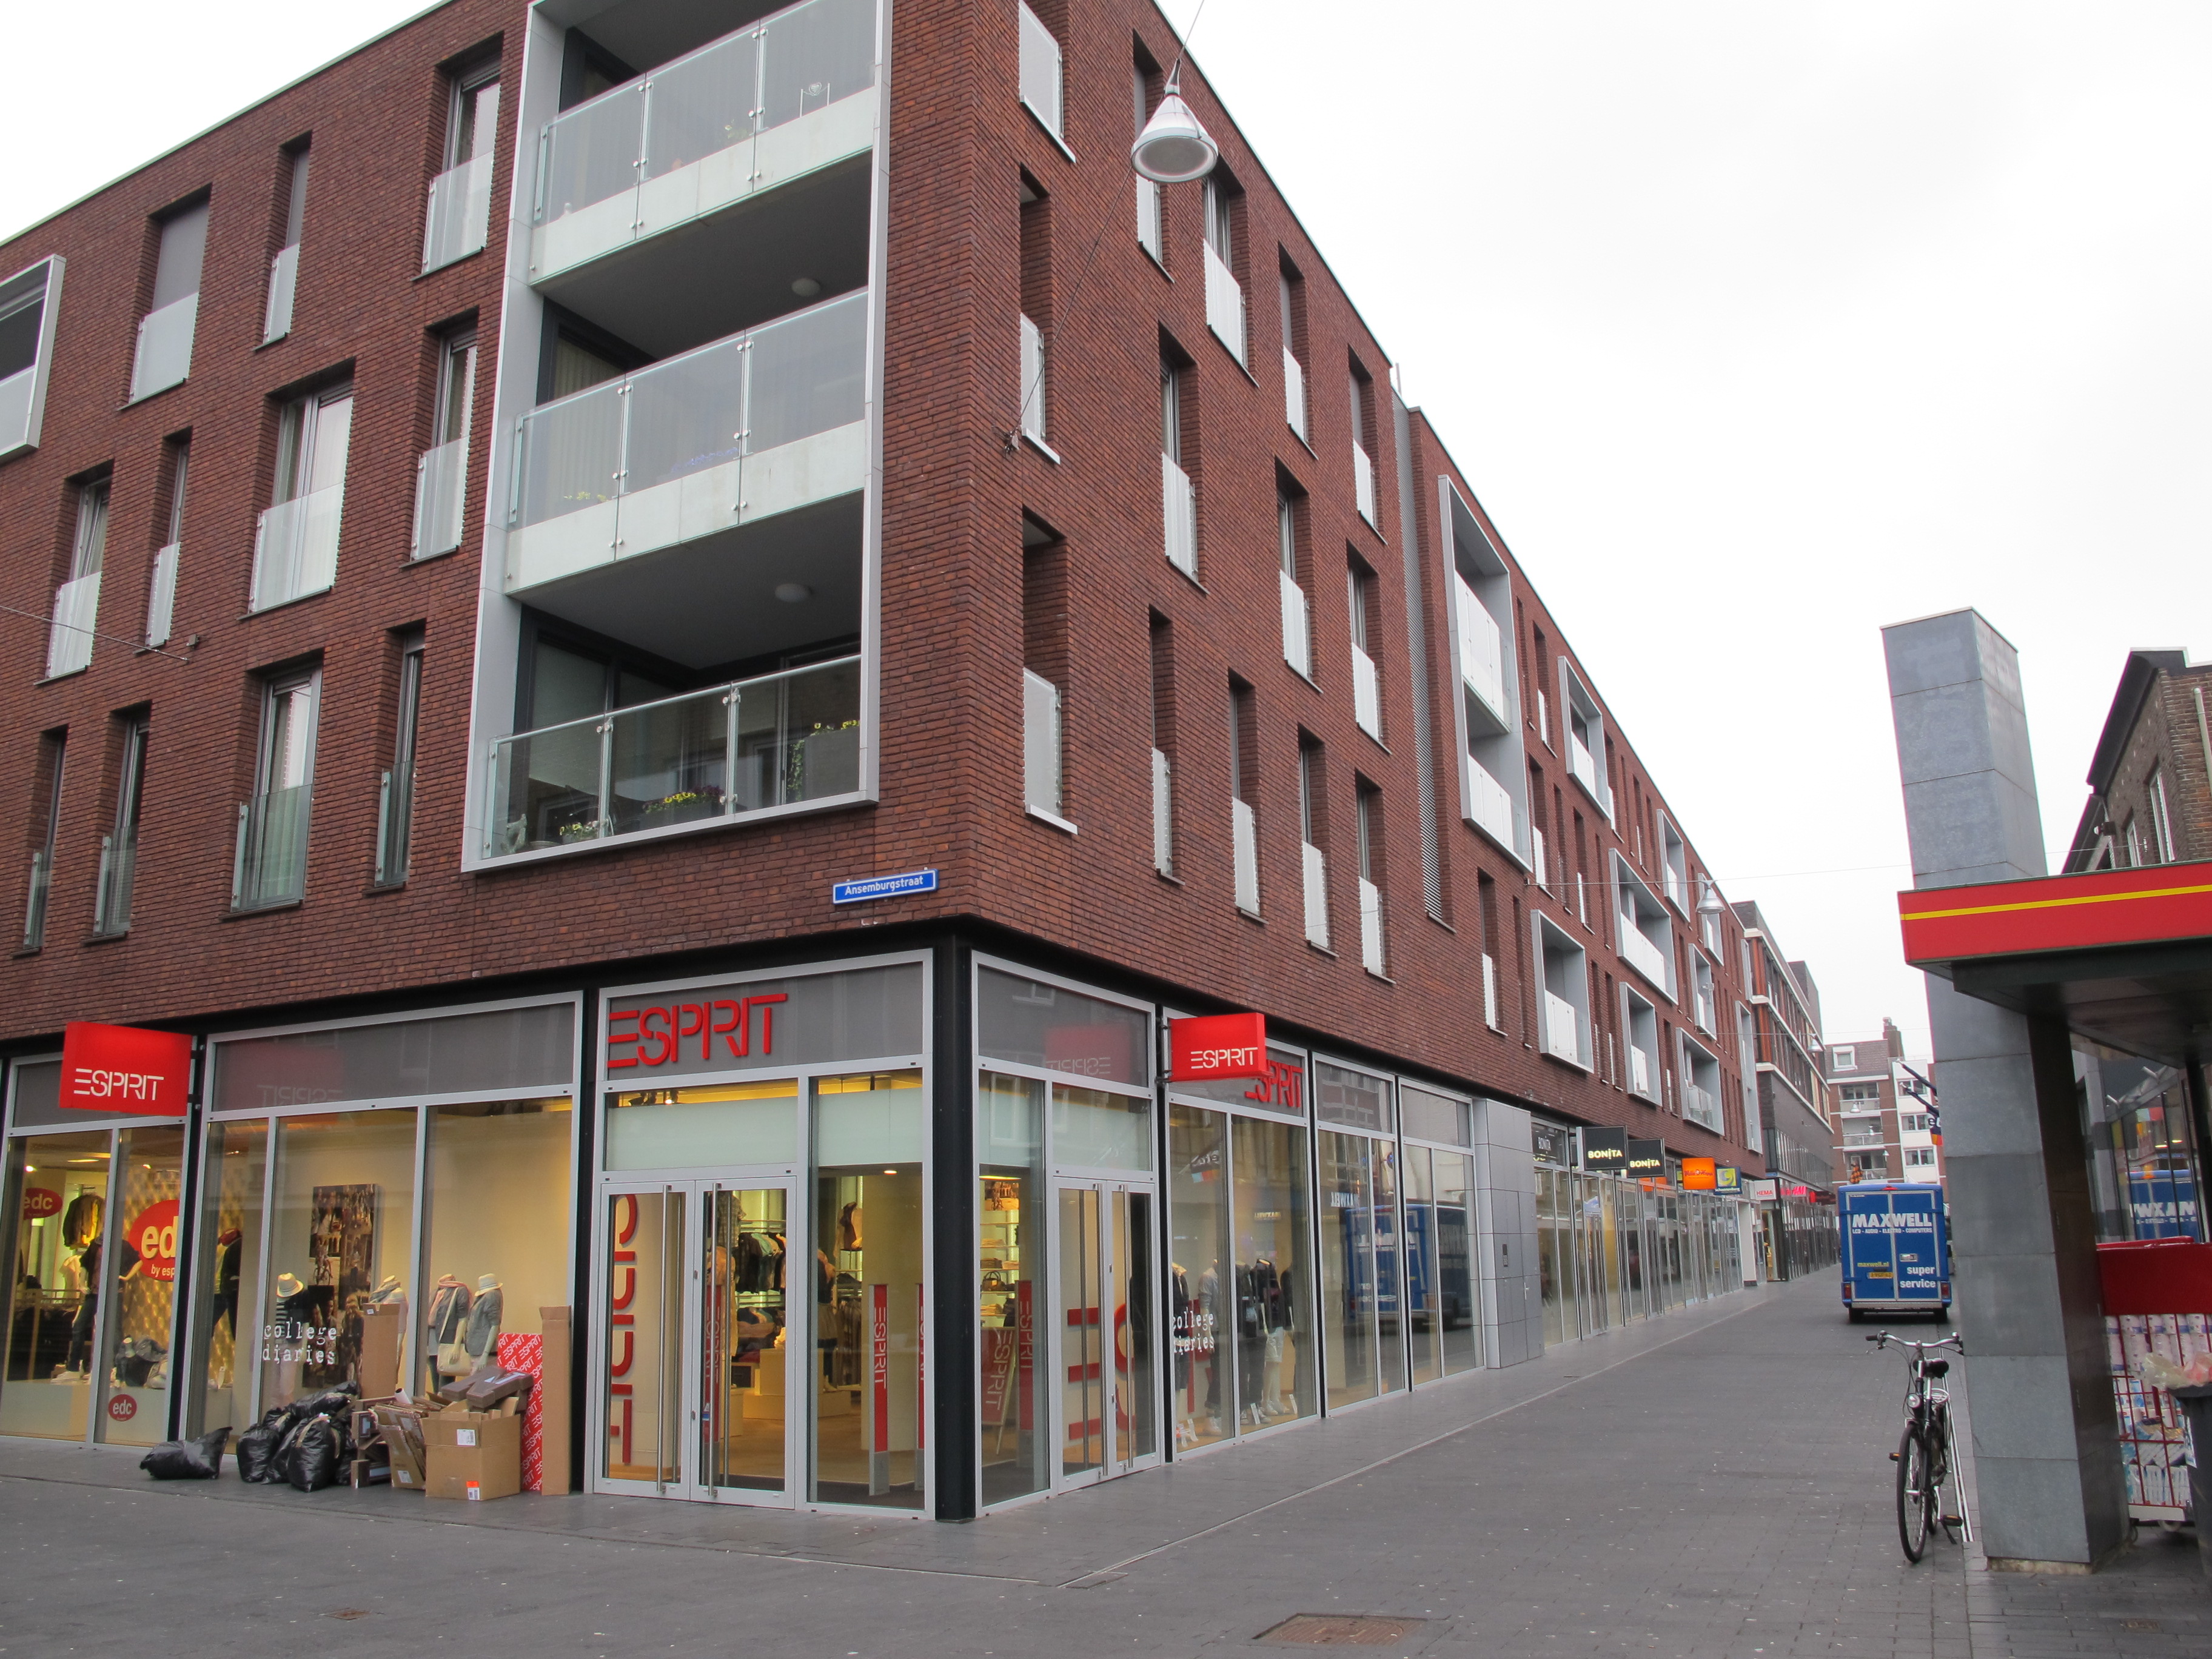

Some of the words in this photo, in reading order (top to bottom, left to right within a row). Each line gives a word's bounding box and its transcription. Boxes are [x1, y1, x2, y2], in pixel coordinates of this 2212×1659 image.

[845, 875, 923, 896] Ansemburgstraat
[608, 993, 787, 1068] ESPRIT
[1190, 1047, 1258, 1069] ESPRIT
[73, 1068, 164, 1101] ESPRIT
[24, 1193, 53, 1210] edc
[1852, 1213, 1932, 1227] MAXWELL
[141, 1216, 179, 1259] ed
[151, 1264, 160, 1278] by
[162, 1267, 175, 1278] esp
[1906, 1267, 1935, 1276] super
[1900, 1279, 1936, 1288] service
[264, 1318, 337, 1346] college
[263, 1344, 336, 1365] diaries
[503, 1333, 525, 1359] ESPRIT
[518, 1334, 541, 1359] ESPRIT
[874, 1307, 886, 1389] ESPRIT
[985, 1328, 1013, 1410] ESPRIT
[113, 1399, 132, 1415] edc
